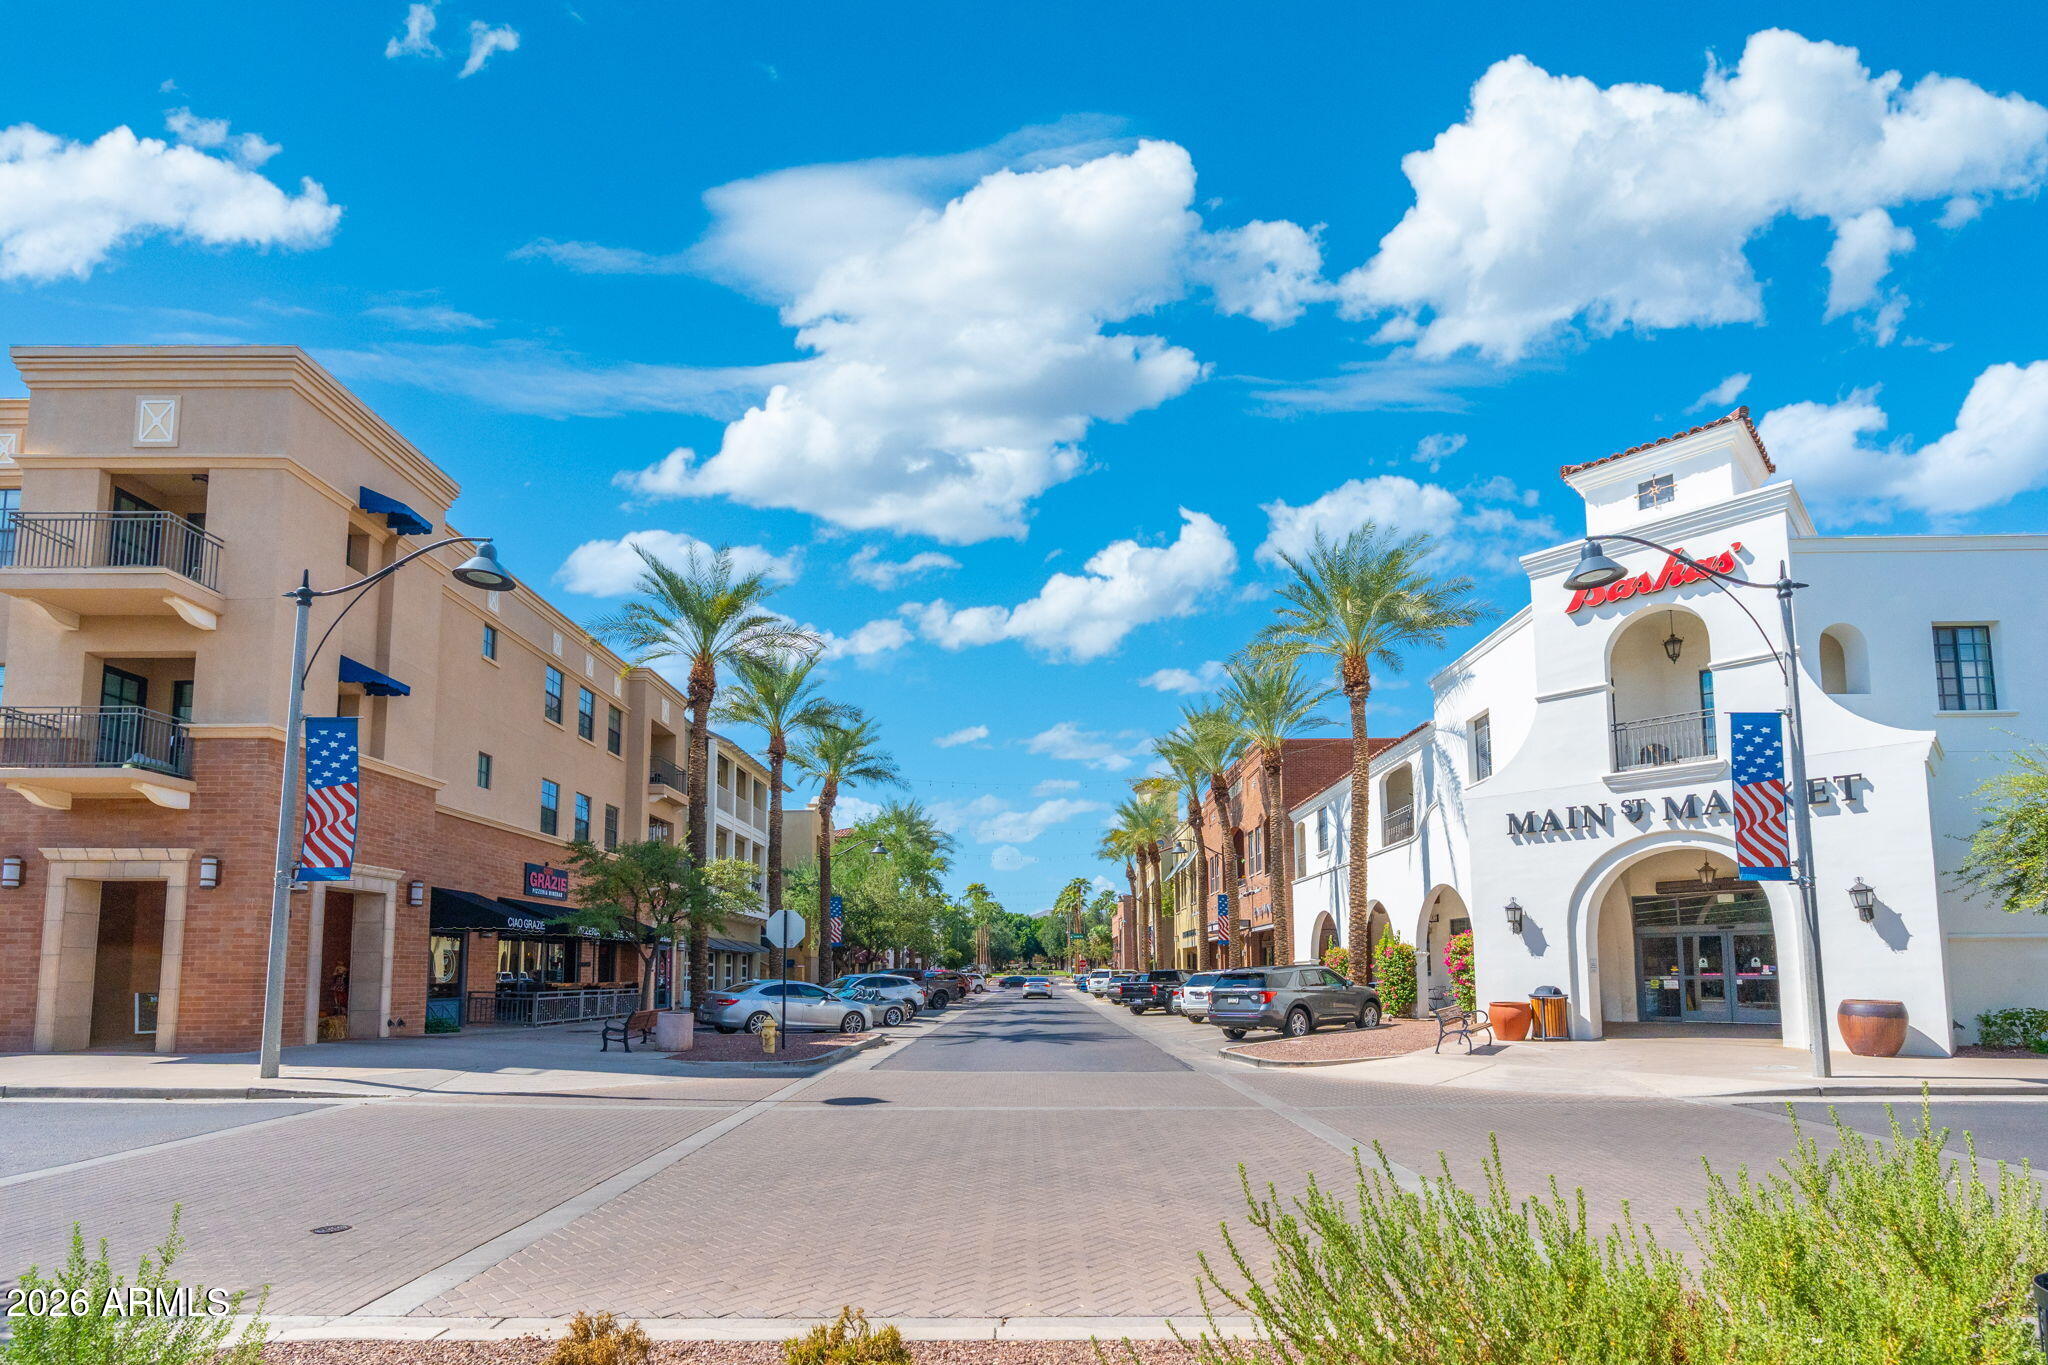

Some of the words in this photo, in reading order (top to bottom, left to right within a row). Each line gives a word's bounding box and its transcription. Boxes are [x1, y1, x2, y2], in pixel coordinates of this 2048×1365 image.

[1506, 803, 1608, 835] MAIN
[1662, 772, 1863, 822] MAET
[530, 871, 568, 892] GRAZIE
[508, 917, 523, 928] CIAO
[524, 919, 546, 930] GRAZIE
